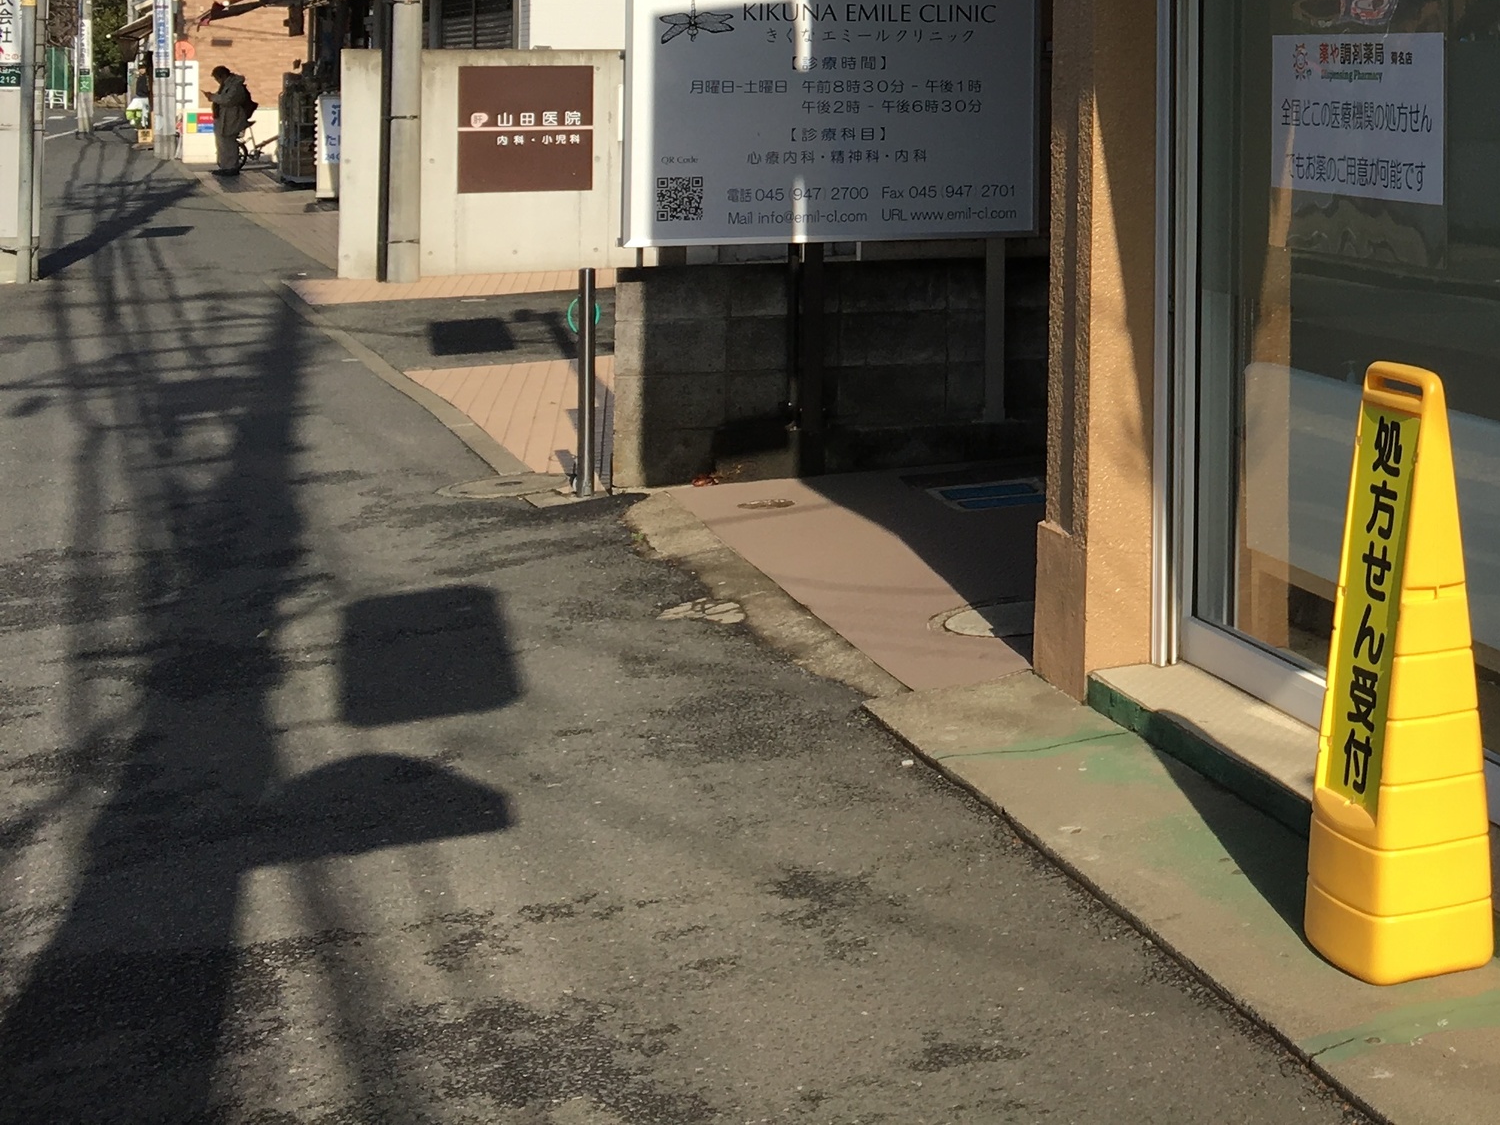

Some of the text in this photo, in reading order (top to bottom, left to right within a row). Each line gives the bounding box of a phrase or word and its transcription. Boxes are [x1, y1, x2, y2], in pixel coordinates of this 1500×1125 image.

[743, 3, 997, 24] KIKUNA EMILE CLINIC
[766, 28, 975, 43] きくなエミールクリニック
[4, 53, 21, 61] この
[1319, 42, 1384, 65] 薬や調剤薬局
[497, 111, 582, 127] 山田医院
[1281, 98, 1433, 133] 全国どこの医療機関の処方せん
[496, 134, 580, 145] 内科・小児科
[755, 188, 785, 202] 045
[831, 187, 869, 201] 2700
[881, 186, 904, 199] Fax
[909, 186, 937, 199] 045
[981, 185, 1016, 198] 2701
[727, 210, 754, 225] Mail
[881, 208, 907, 222] URL
[1342, 415, 1403, 795] 処方せん受付
